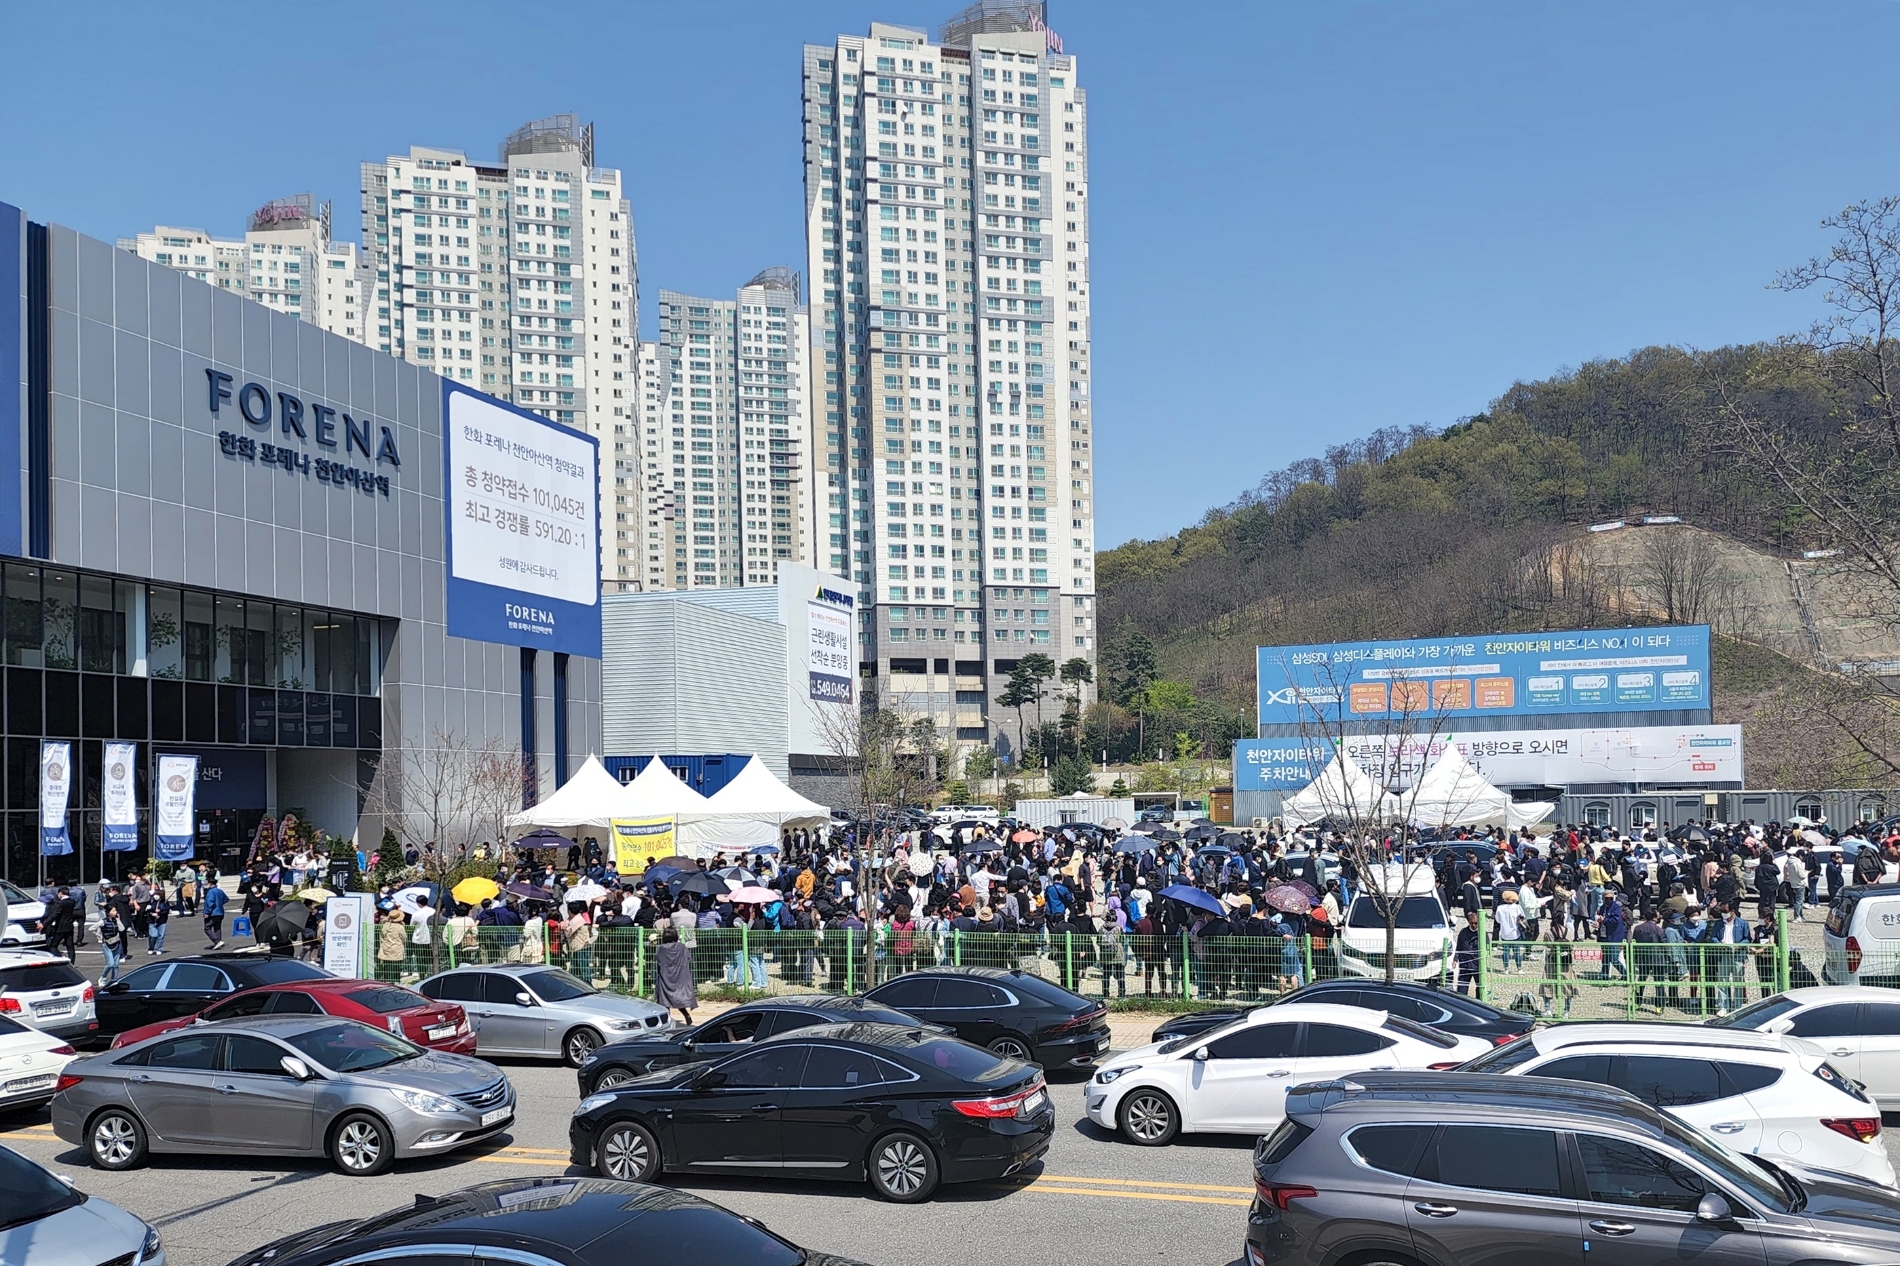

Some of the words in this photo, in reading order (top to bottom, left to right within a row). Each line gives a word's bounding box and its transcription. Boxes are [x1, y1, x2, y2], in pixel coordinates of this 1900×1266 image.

[205, 368, 401, 466] FORENA
[463, 425, 483, 445] 한화
[485, 432, 511, 455] 포레나
[512, 442, 553, 470] 천안아산역
[554, 457, 585, 480] 청약결과
[219, 431, 257, 460] 한화
[260, 442, 311, 475] 포레나
[315, 457, 390, 497] 천안아산역
[464, 465, 478, 488] 총
[481, 470, 530, 503] 청약접수
[533, 487, 585, 521] 101,045건
[465, 500, 491, 523] 최고
[494, 507, 530, 537] 경쟁률
[535, 519, 572, 546] 591.20
[498, 556, 519, 572] 성원에
[519, 561, 559, 580] 감사드립니다.
[505, 603, 555, 625] FORENA
[508, 621, 518, 630] 한화
[518, 622, 531, 632] 포레나
[531, 624, 553, 636] 천안아산역
[811, 627, 848, 650] 근린생활시설
[1333, 647, 1415, 663] 삼성디스플레이와
[1418, 645, 1441, 659] 가장
[1443, 643, 1476, 657] 가까운
[1485, 639, 1551, 655] 천안자이타워
[1554, 637, 1600, 652] 비즈니스
[1602, 637, 1628, 649] NO.1
[1632, 635, 1644, 648] 이
[1647, 634, 1671, 648] 되다
[810, 648, 830, 667] 선착순
[830, 654, 849, 671] 분양중
[1554, 679, 1560, 690] 1
[1598, 678, 1607, 689] 2
[1643, 676, 1652, 687] 3
[1689, 674, 1698, 685] 4
[1246, 746, 1325, 764] 천안자이타워
[1348, 744, 1385, 759] 오른쪽
[1387, 743, 1426, 757] 보라색
[1472, 741, 1525, 757] 방향으로
[1528, 739, 1569, 755] 오시면
[201, 767, 222, 781] 산다
[1260, 766, 1312, 781] 주차안내
[1357, 763, 1385, 779] 차장
